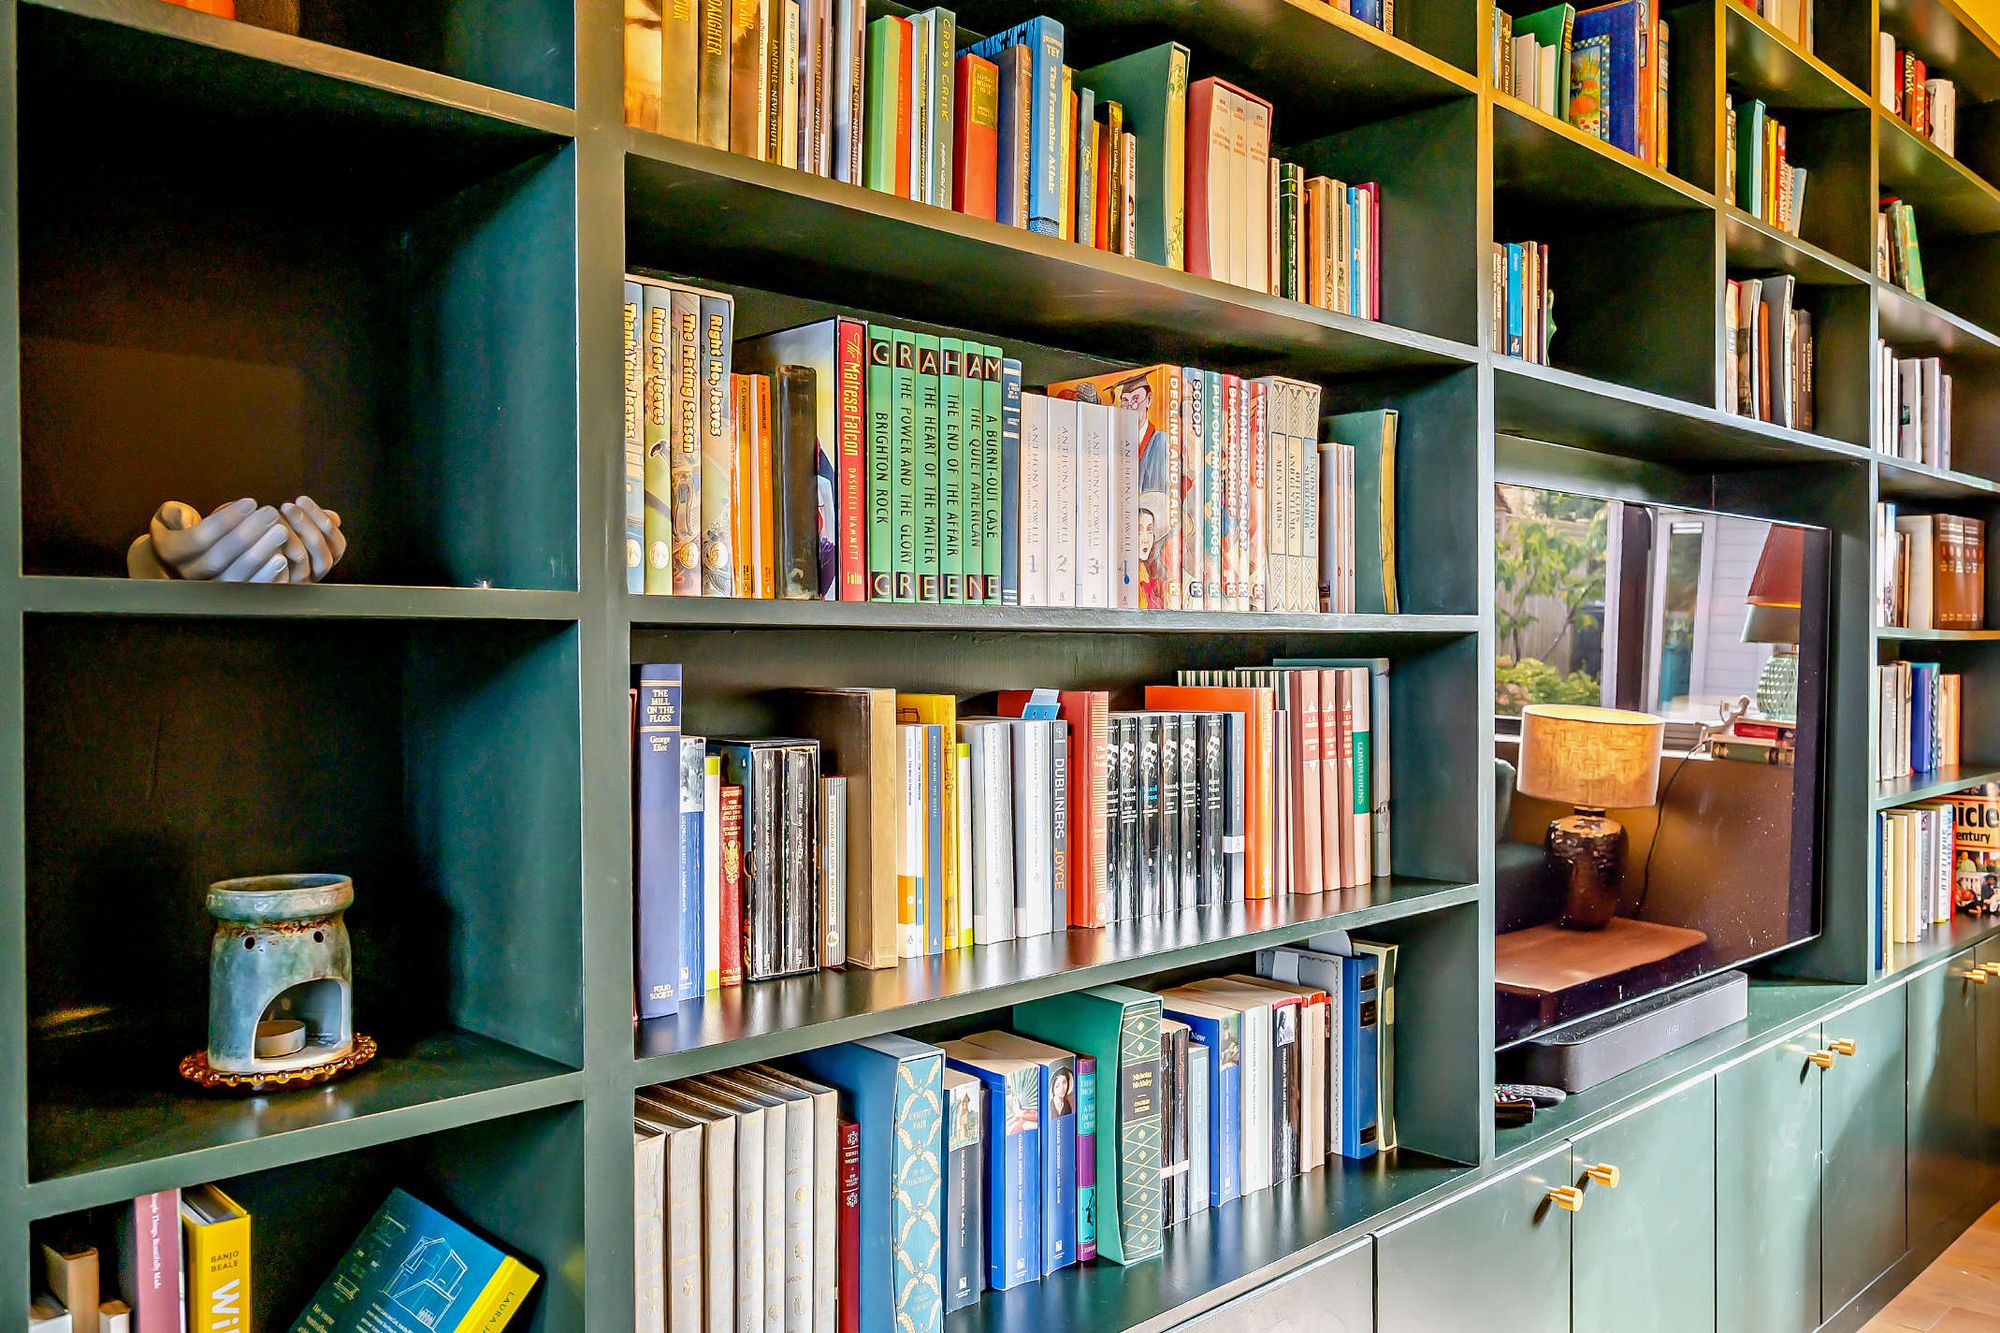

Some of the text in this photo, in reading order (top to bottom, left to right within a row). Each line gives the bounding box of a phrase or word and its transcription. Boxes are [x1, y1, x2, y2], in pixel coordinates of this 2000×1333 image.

[1046, 45, 1060, 59] TEY
[1048, 92, 1057, 151] Franchise
[1048, 154, 1056, 193] Affair
[650, 307, 666, 426] Ring for Jeeves
[708, 314, 723, 436] Right Ho, Jeeves
[872, 342, 1000, 381] GRAHAM
[682, 314, 696, 454] The Mating Season
[843, 332, 862, 456] The Maltese Falcon
[1192, 380, 1202, 437] SCOOP
[876, 412, 888, 524] BRIGHTON ROCK
[900, 376, 912, 564] THE POWER AND THE GLORY
[986, 430, 998, 505] BURNT-OUT
[1169, 378, 1179, 526] DECLINE AND FALL
[1211, 384, 1220, 555] PUT OUT MORE FLAGS
[1228, 386, 1237, 518] BLACK MISCHIEF
[924, 386, 937, 564] THE HEART OF THE MATTER
[946, 393, 959, 556] THE END OF THE AFFAIR
[971, 407, 980, 547] THE QUIET AMERICAN
[1240, 481, 1247, 501] OF
[848, 468, 859, 561] DASHIELL HAMMETT
[986, 509, 998, 538] CASE
[872, 574, 1000, 598] GREENE
[652, 689, 669, 697] THE
[649, 714, 672, 723] FLOSS
[650, 736, 671, 744] George
[1054, 758, 1065, 891] DUBLINERS JOYCE
[649, 990, 673, 999] SOCIETY
[652, 984, 672, 992] FOLIO
[1190, 1032, 1206, 1043] Now
[1132, 1072, 1152, 1080] Nicholas
[1133, 1079, 1152, 1089] Nickleby
[908, 1108, 931, 1121] VANITY
[913, 1120, 927, 1130] FAIR
[150, 1214, 161, 1238] Things,
[150, 1238, 161, 1270] Beautifully
[210, 1251, 239, 1263] BANJO
[211, 1260, 239, 1272] BEALE
[489, 1291, 515, 1325] LAURA
